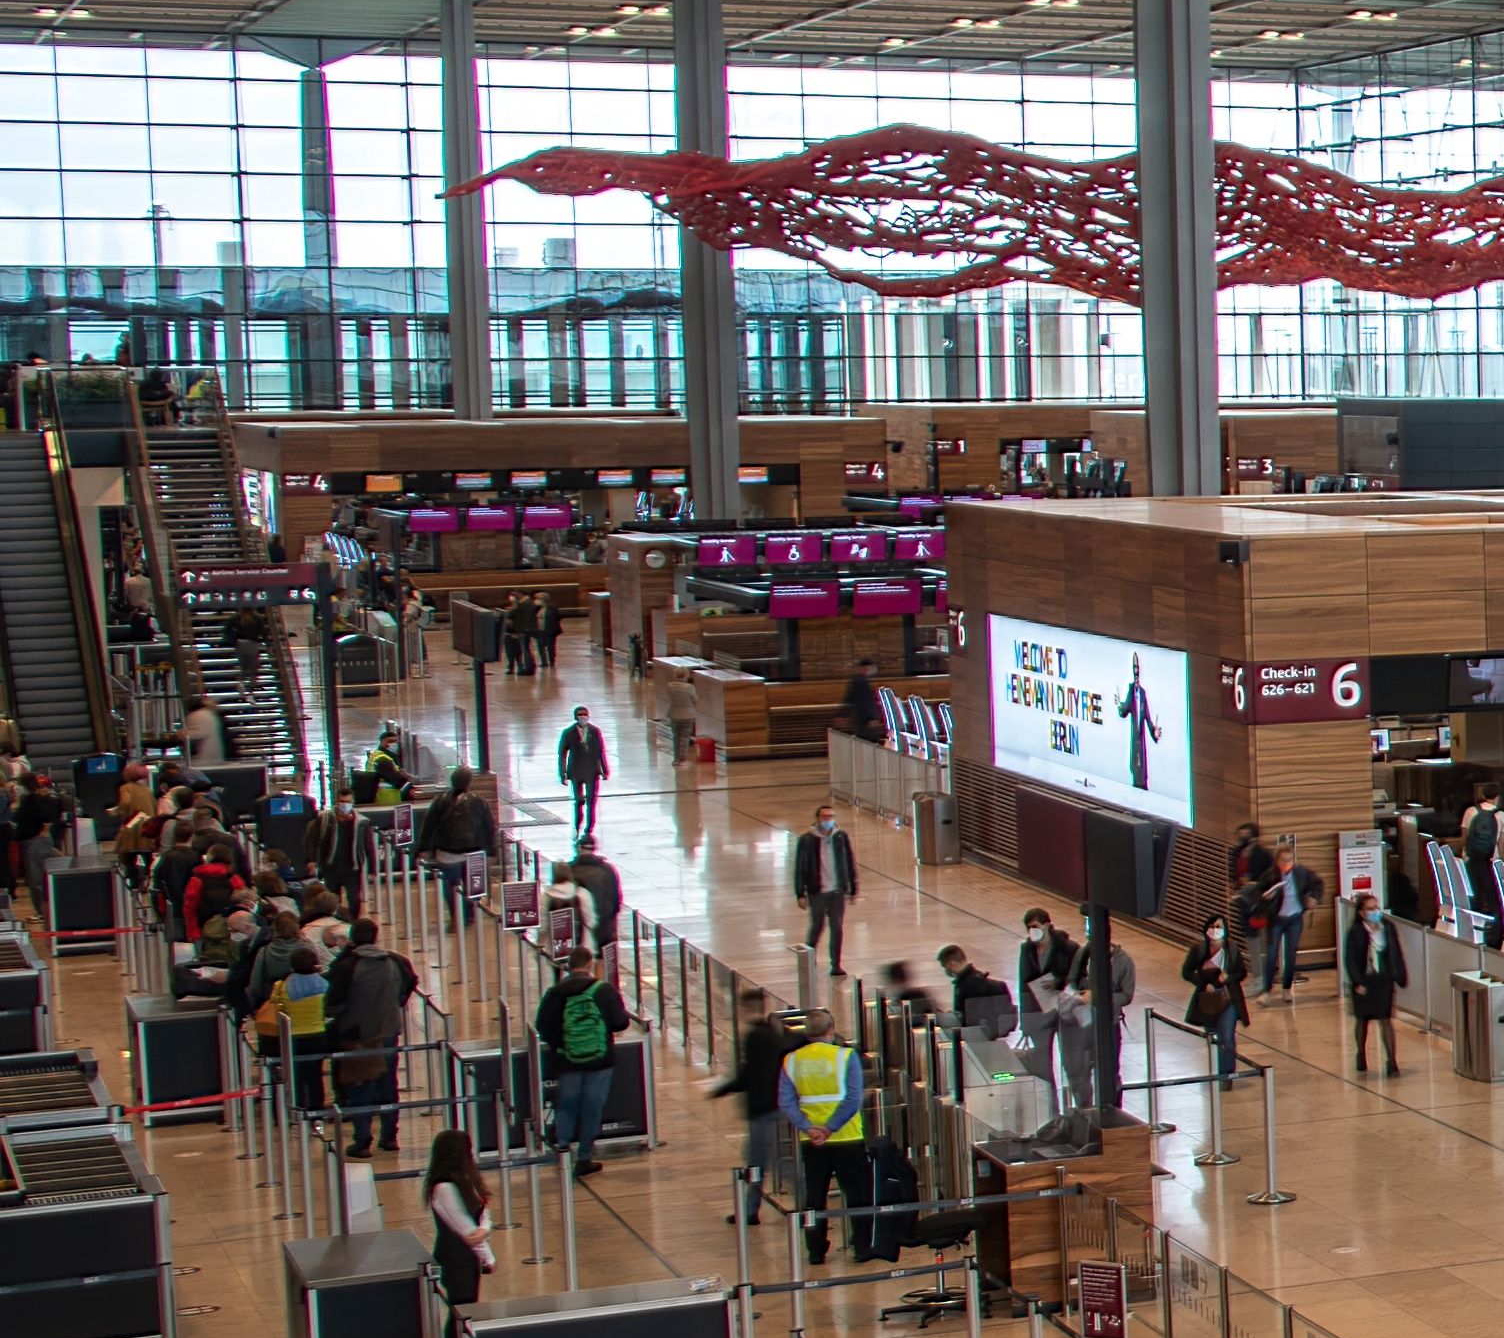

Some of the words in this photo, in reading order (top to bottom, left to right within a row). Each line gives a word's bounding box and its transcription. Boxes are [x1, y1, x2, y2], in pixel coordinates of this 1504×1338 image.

[957, 439, 965, 453] 1
[871, 463, 885, 479] 4
[1262, 458, 1273, 474] 3
[313, 474, 328, 491] 4
[957, 610, 965, 646] 6
[1014, 639, 1054, 677] WELCOME
[1056, 647, 1068, 679] TO
[1261, 665, 1316, 680] Check-in
[1332, 662, 1362, 707] 6
[1006, 672, 1054, 713] HEINEMANN
[1057, 684, 1080, 719] DUTY
[1081, 690, 1103, 725] FREE
[1234, 667, 1245, 711] 6
[1261, 683, 1315, 697] 626–621
[1050, 718, 1080, 756] BERLIN
